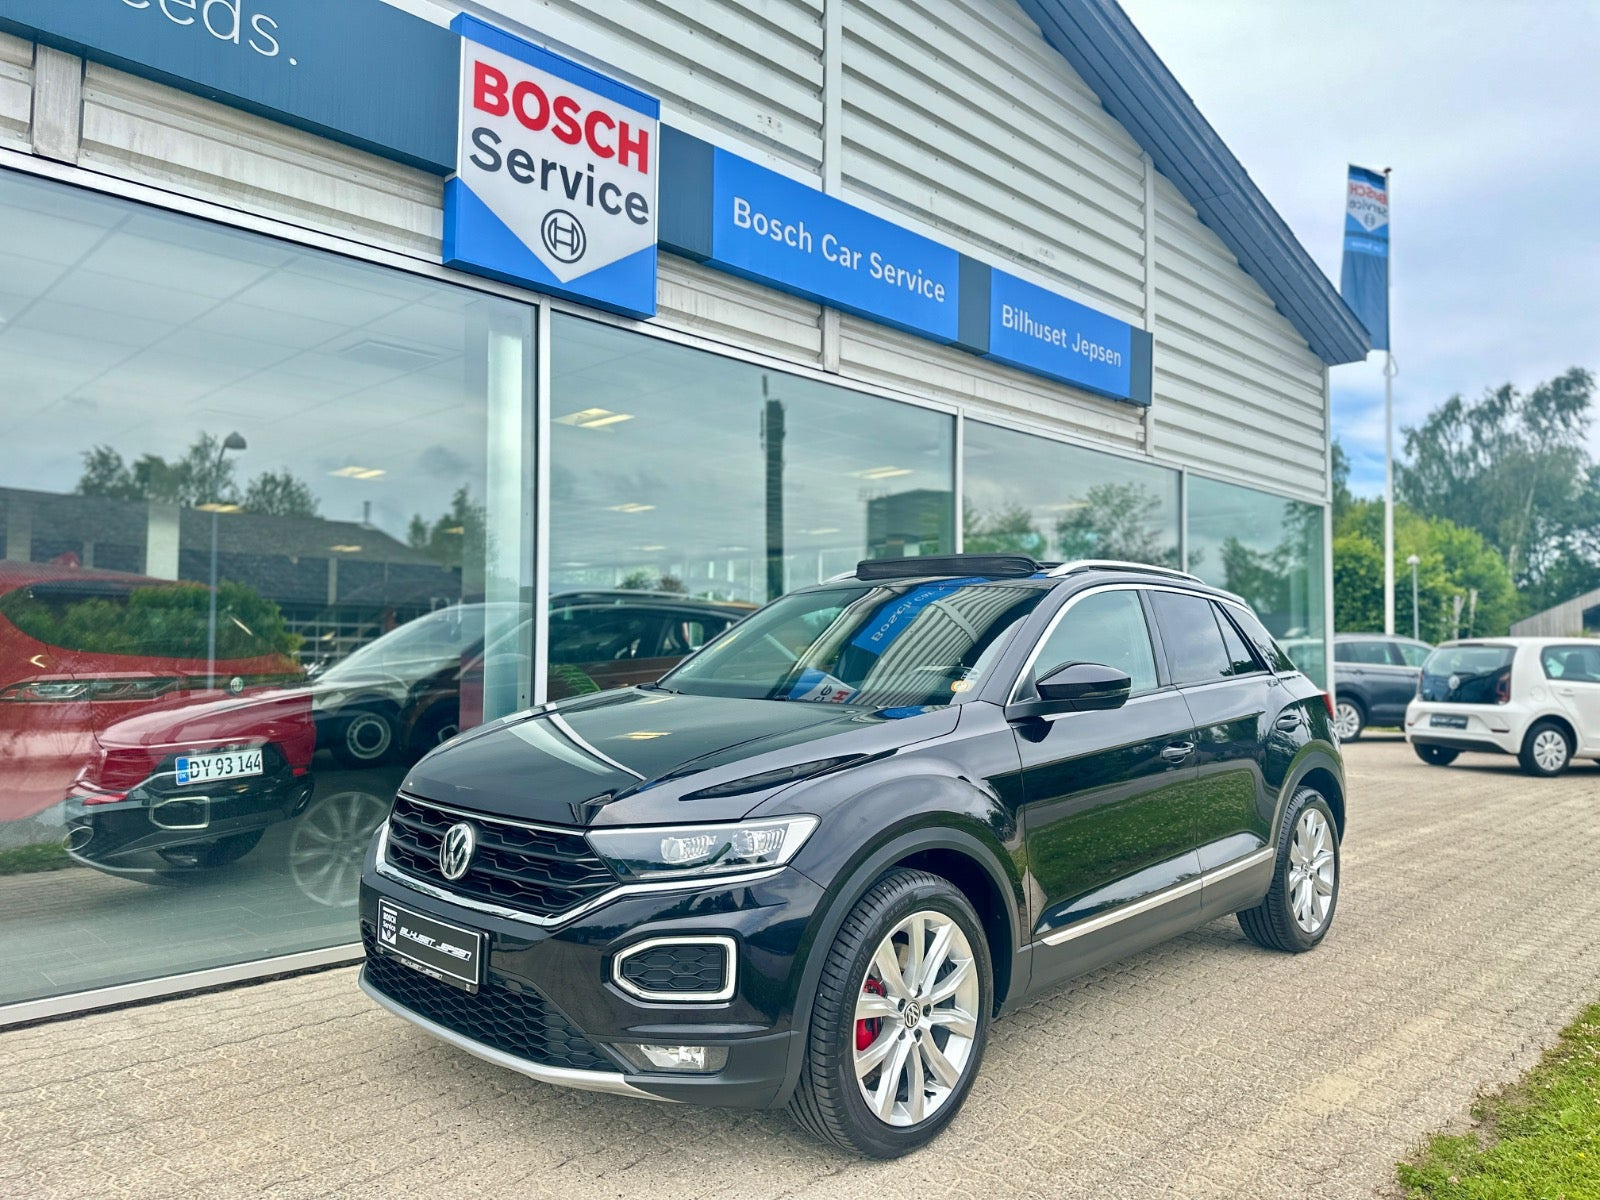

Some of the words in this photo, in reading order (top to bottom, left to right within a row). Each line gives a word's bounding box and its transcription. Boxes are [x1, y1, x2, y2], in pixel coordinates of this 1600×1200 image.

[121, 0, 298, 66] eds.
[473, 60, 649, 175] BOSCH
[469, 126, 649, 225] Service
[733, 196, 812, 254] Bosch
[822, 233, 862, 271] Car
[869, 252, 946, 303] Service
[1002, 303, 1067, 348] Bilhuset
[1071, 333, 1122, 368] Jepsen
[190, 759, 211, 778] DY
[215, 757, 233, 776] 93
[238, 753, 261, 773] 144
